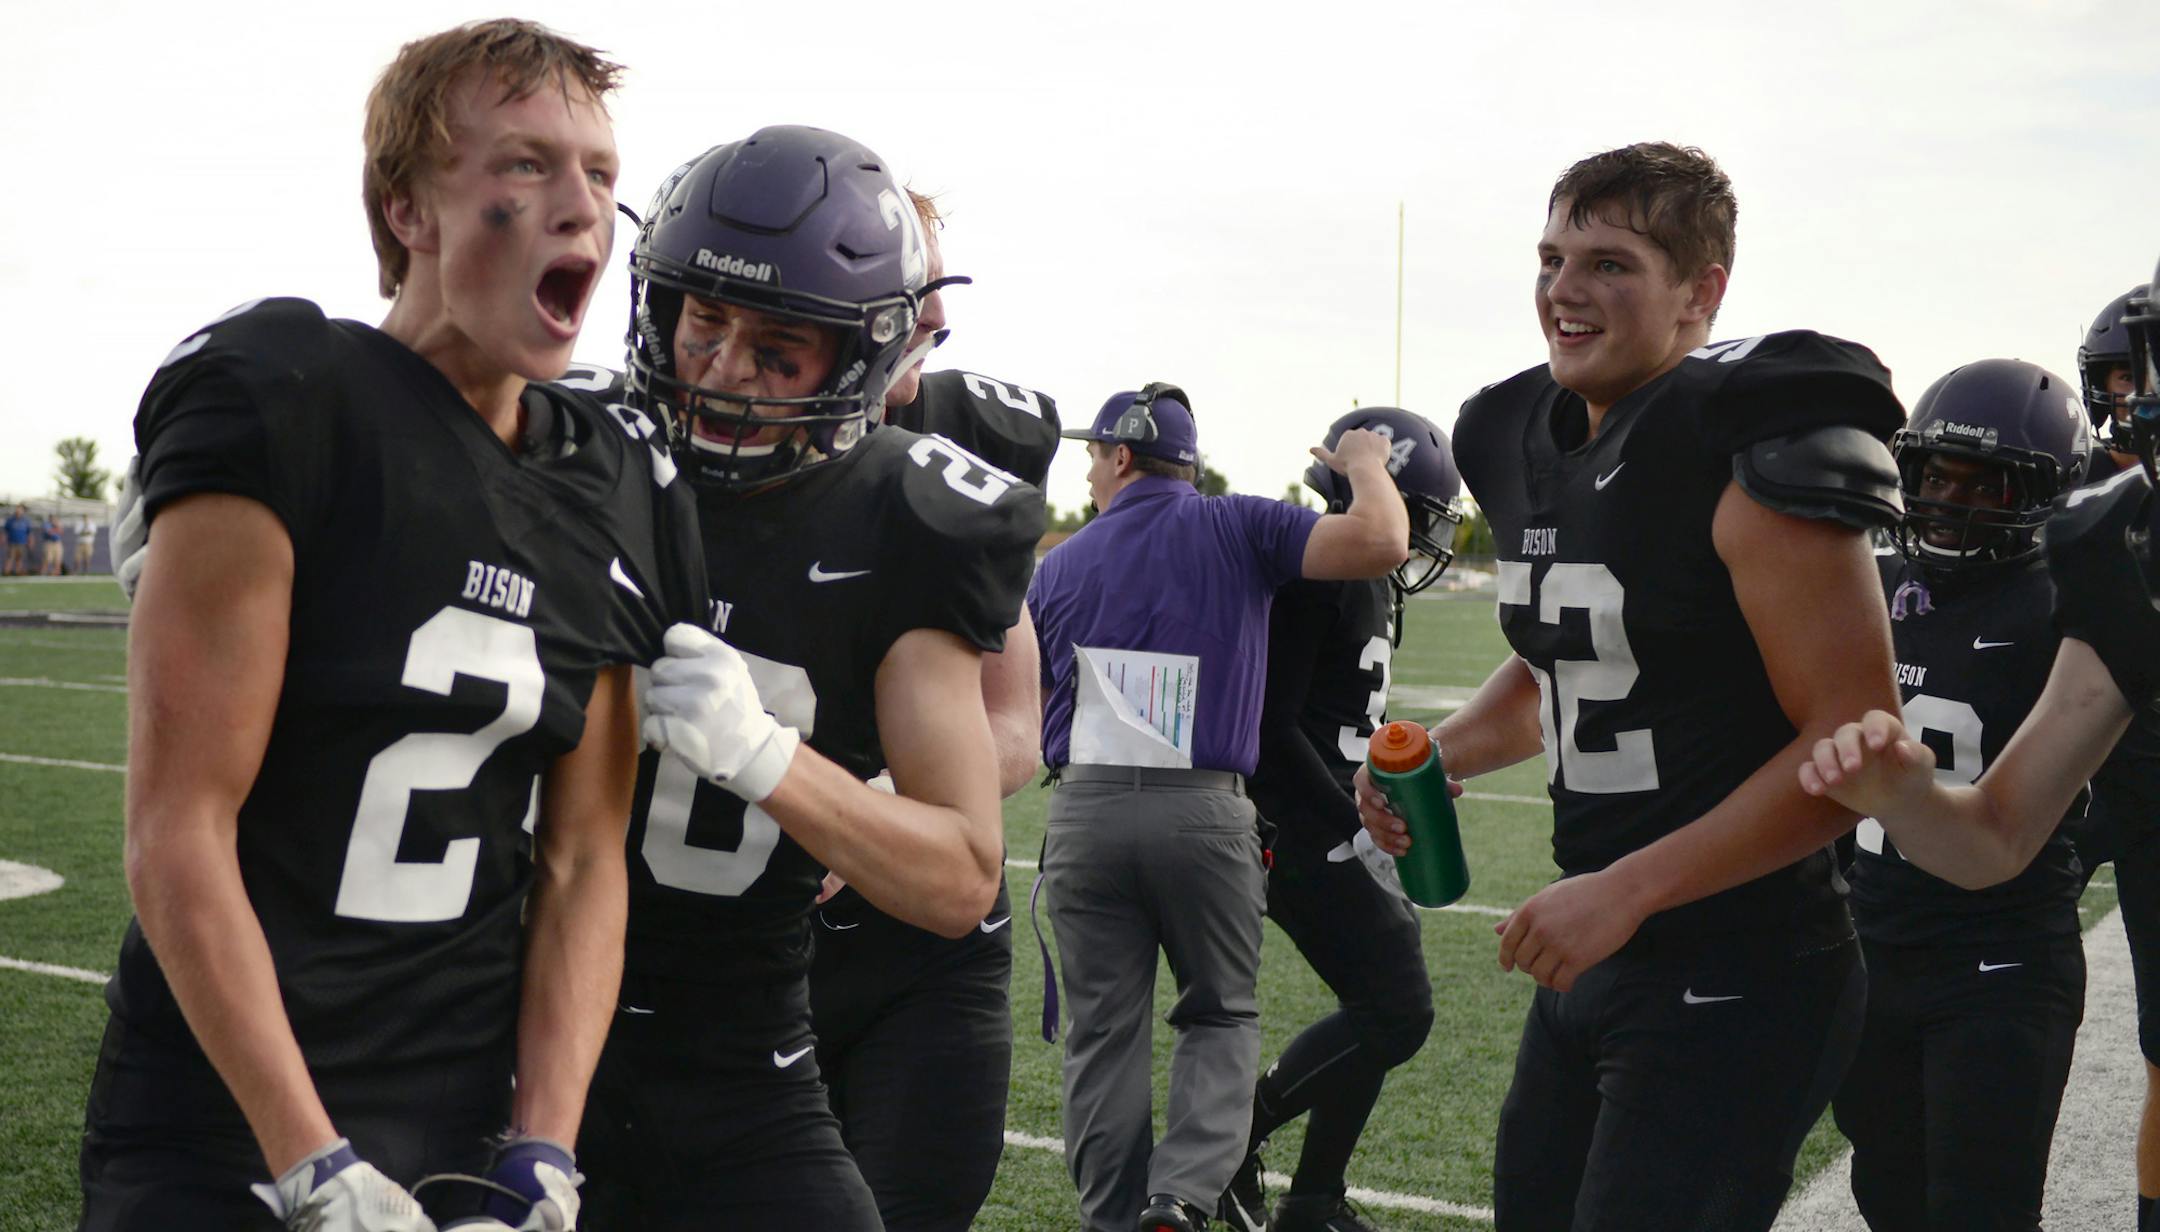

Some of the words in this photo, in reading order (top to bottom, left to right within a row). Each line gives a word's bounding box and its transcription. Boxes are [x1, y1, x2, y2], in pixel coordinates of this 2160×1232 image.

[878, 187, 927, 287] 2
[695, 248, 772, 282] Riddell
[1127, 417, 1140, 434] P
[1945, 422, 1985, 438] Riddell
[908, 432, 1024, 506] 2
[1521, 528, 1558, 556] BISON
[461, 559, 536, 619] BISON
[1496, 559, 1661, 794] 52
[1893, 662, 1928, 687] ISON
[335, 604, 545, 923] 2
